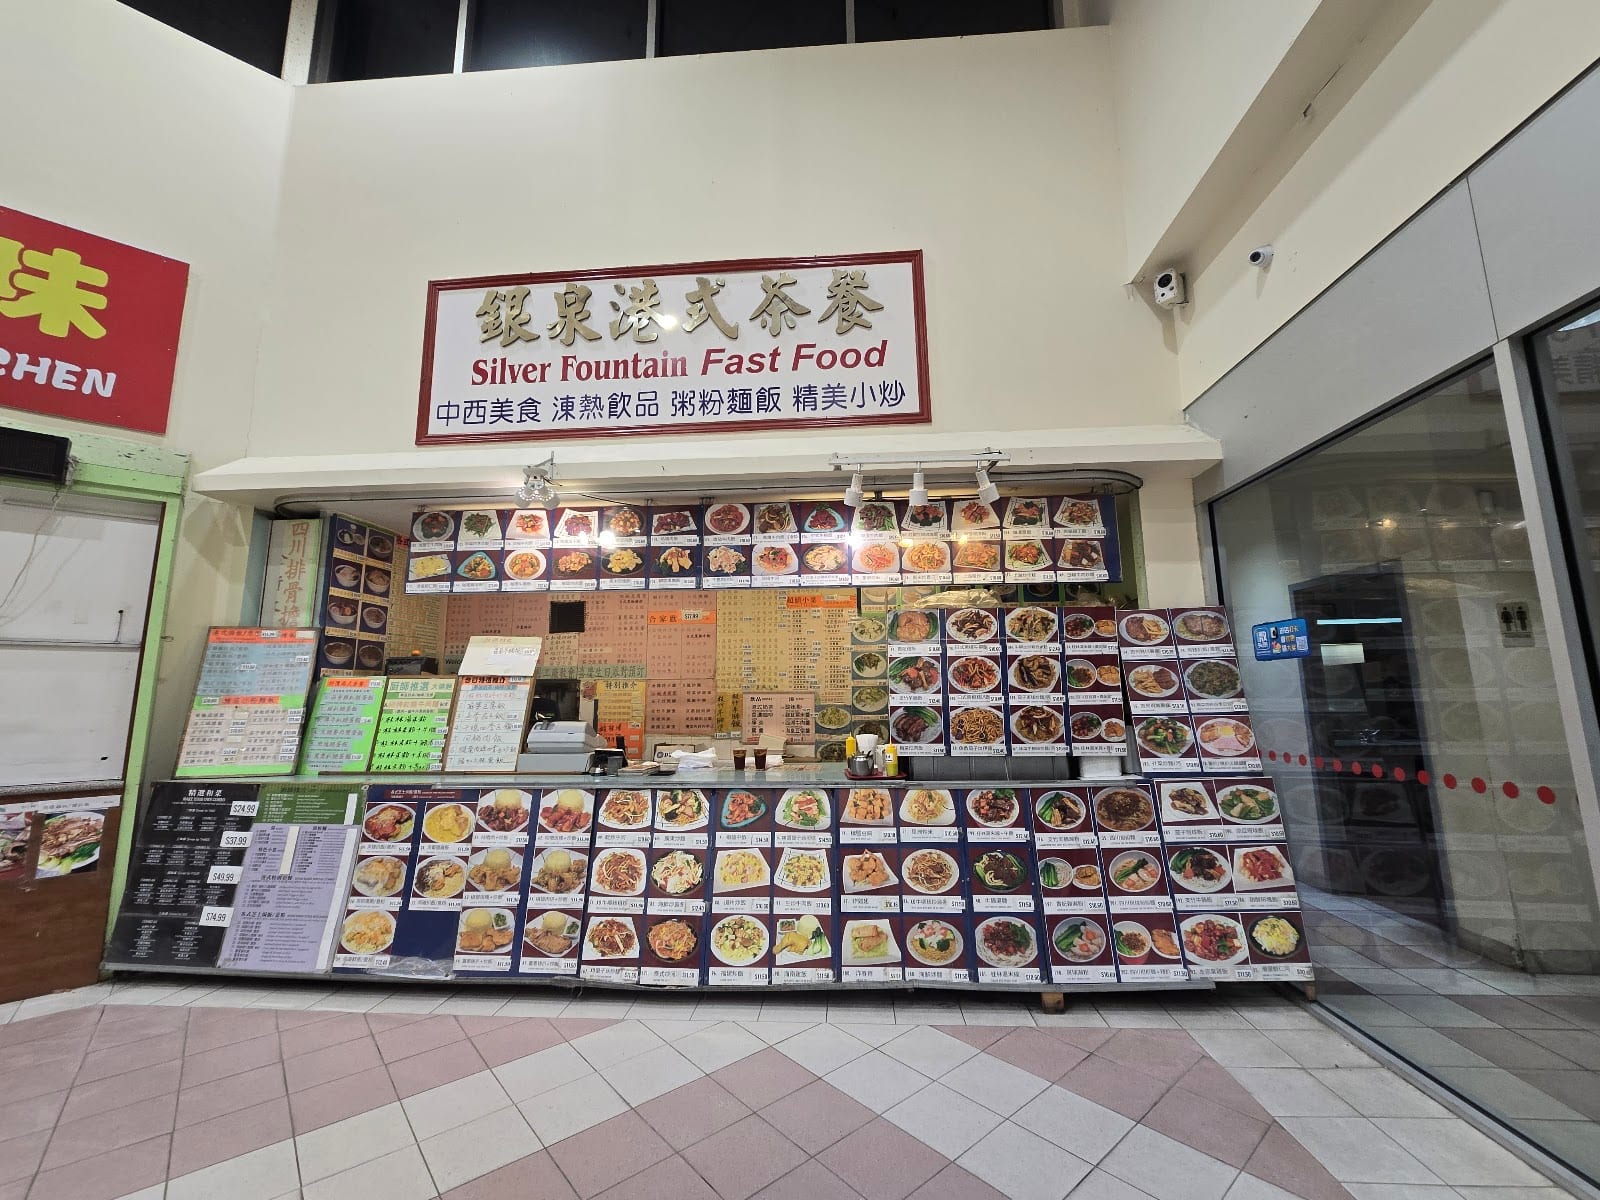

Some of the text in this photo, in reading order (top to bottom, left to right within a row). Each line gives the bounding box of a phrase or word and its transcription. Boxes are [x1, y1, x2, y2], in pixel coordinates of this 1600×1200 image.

[475, 269, 885, 347] 銀泉港式茶餐
[471, 340, 889, 387] Silver Fountain Fast Food
[436, 396, 541, 426] 中西美食
[670, 386, 782, 416] 粥粉麵飯
[792, 379, 906, 412] 精美小炒
[232, 804, 256, 814] $24.99
[225, 836, 247, 845] $37.99
[212, 872, 235, 882] $49.99
[205, 912, 227, 922] $74.99
